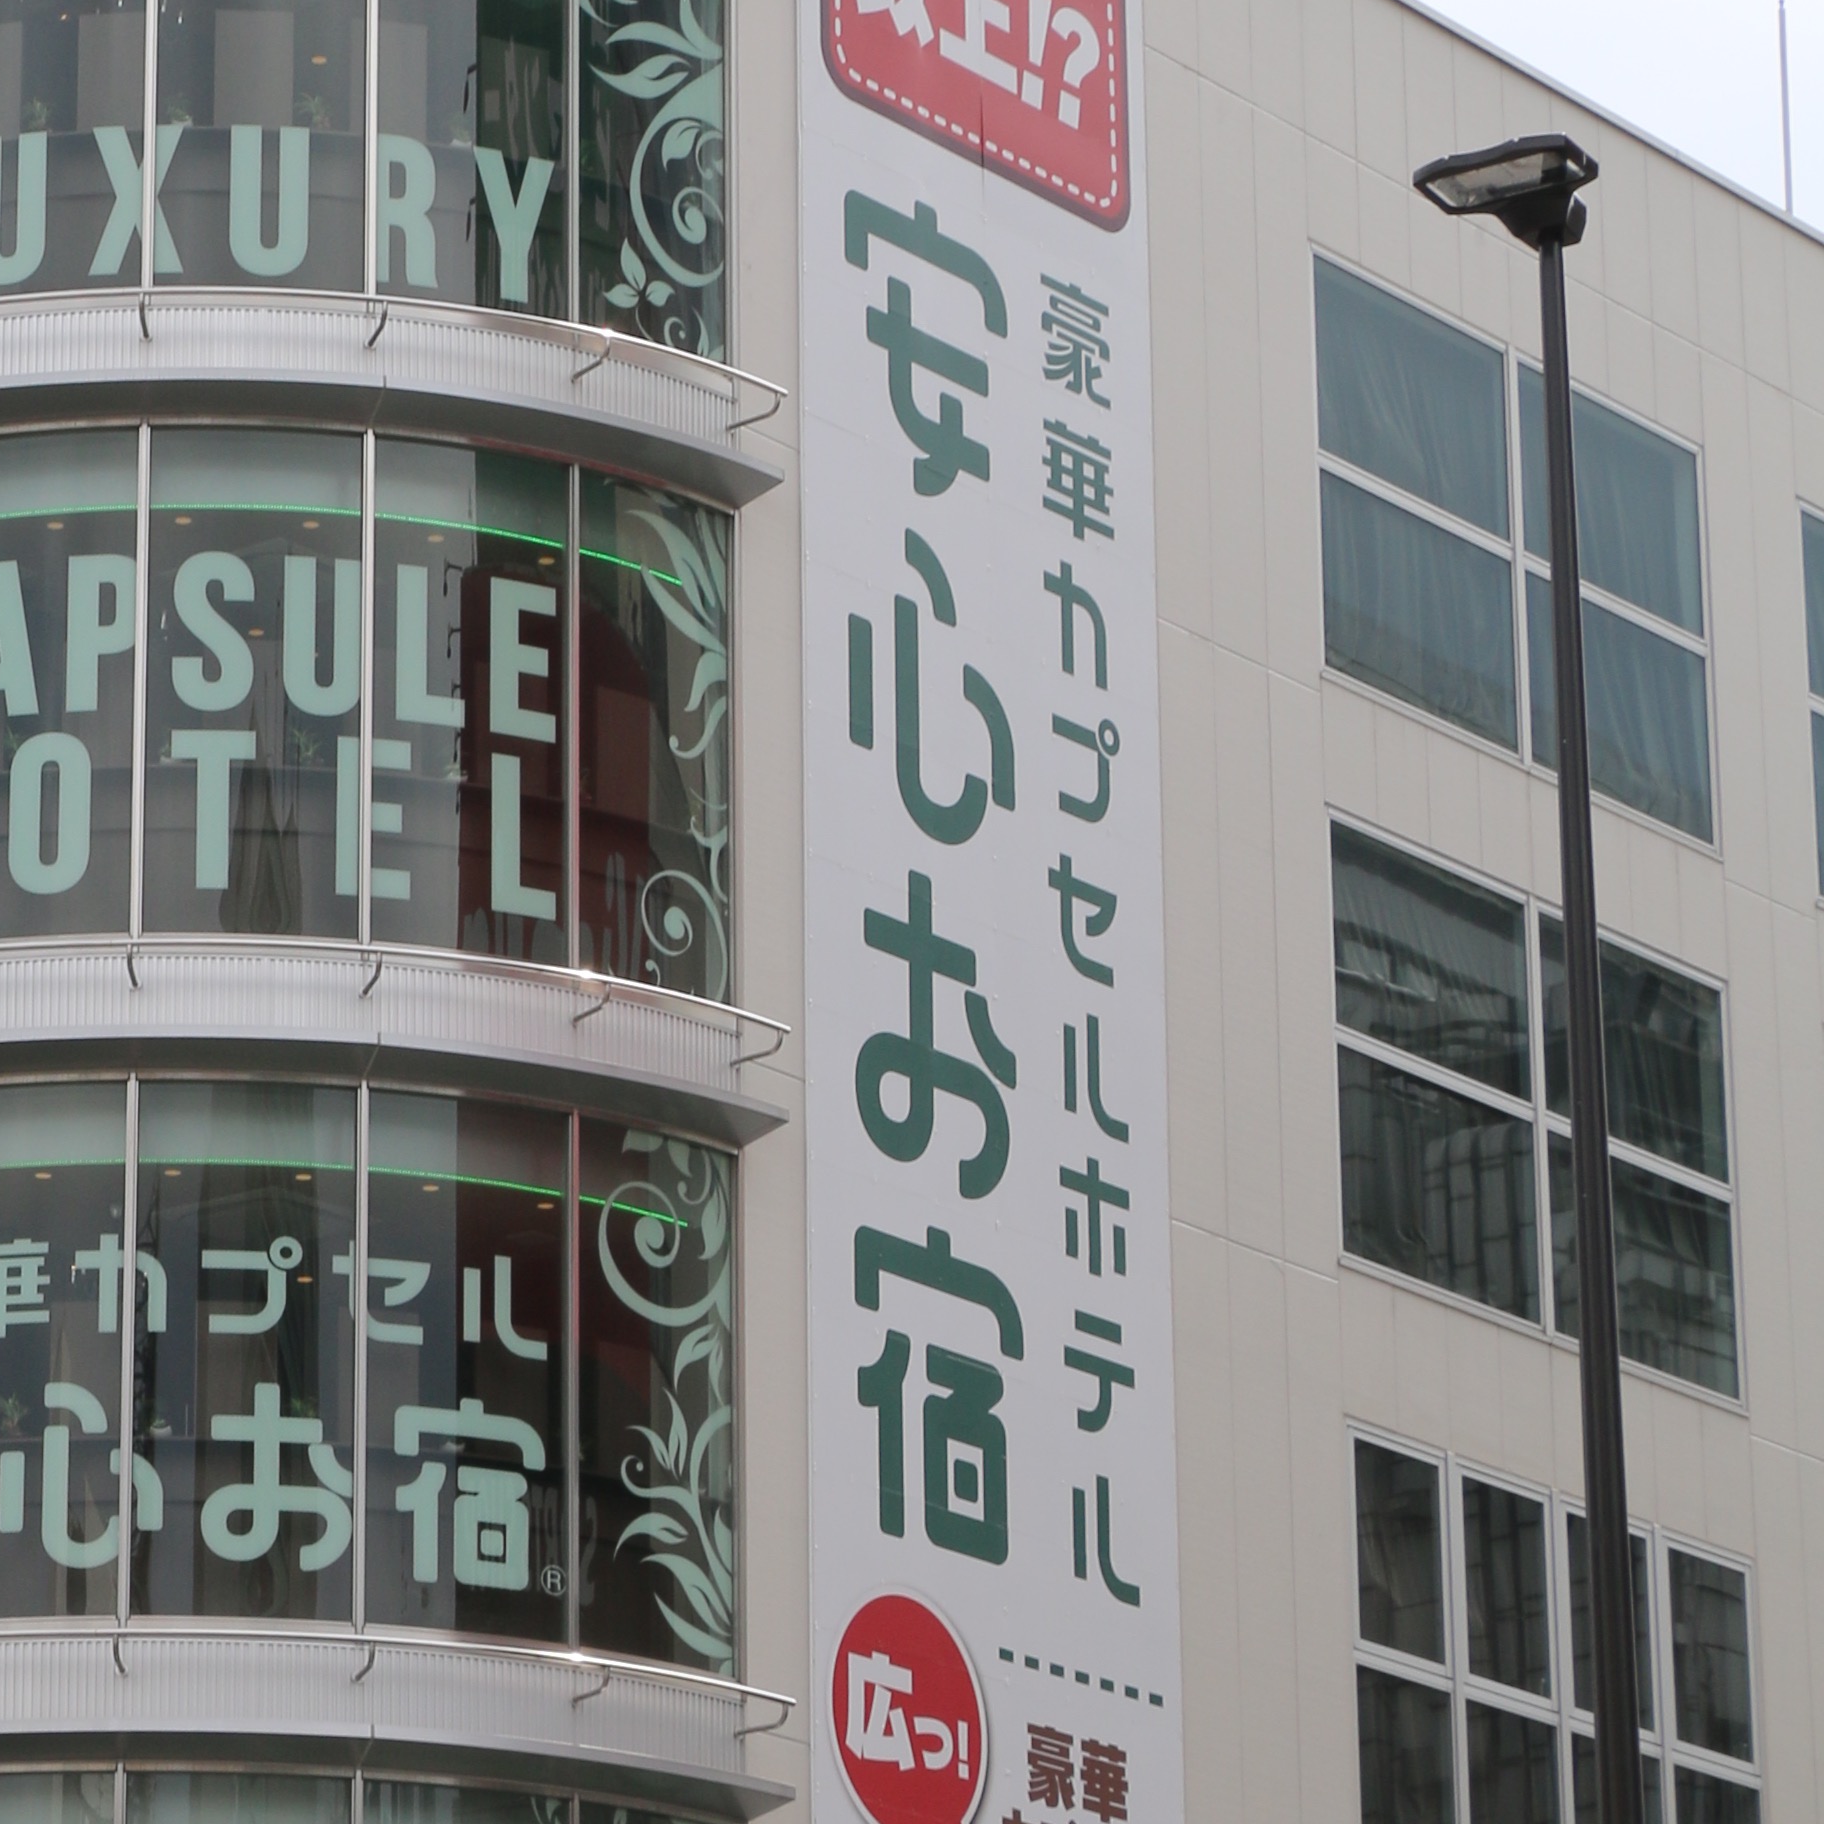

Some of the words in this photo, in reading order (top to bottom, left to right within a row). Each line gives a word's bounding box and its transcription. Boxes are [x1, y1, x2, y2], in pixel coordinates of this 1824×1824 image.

[843, 188, 1026, 1567] 安心お宿
[1038, 270, 1144, 1610] 豪華カプセルホテル
[844, 1649, 971, 1782] 広っ!
[1026, 1721, 1130, 1824] 豪華
